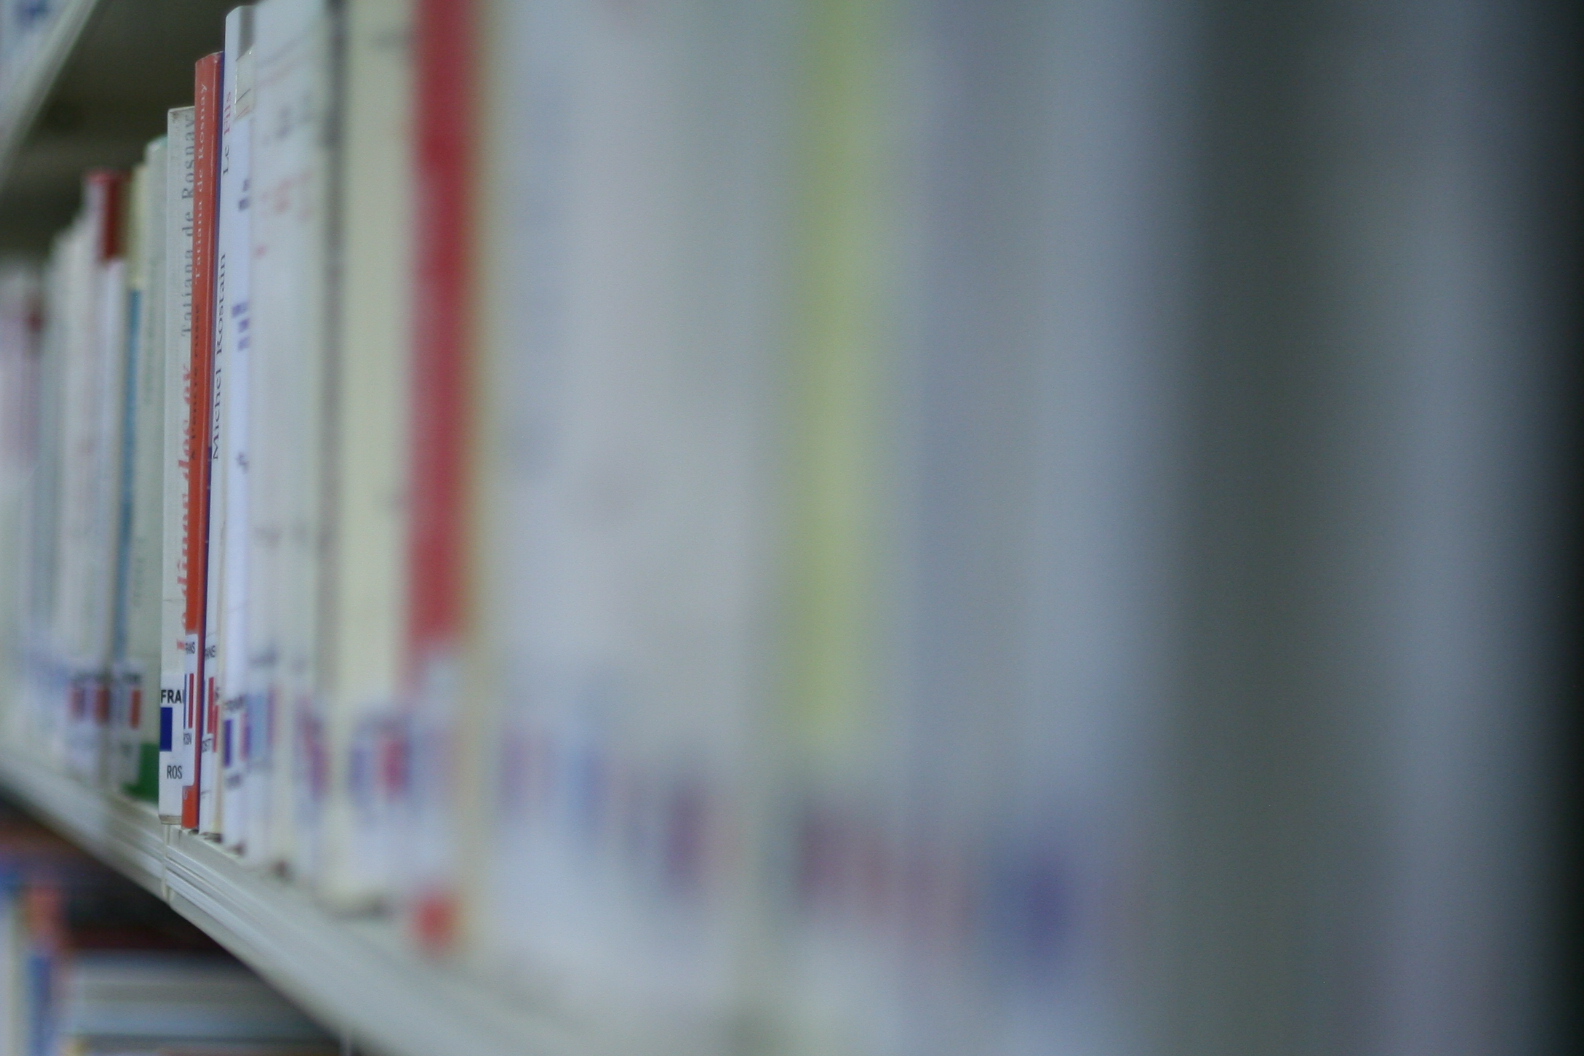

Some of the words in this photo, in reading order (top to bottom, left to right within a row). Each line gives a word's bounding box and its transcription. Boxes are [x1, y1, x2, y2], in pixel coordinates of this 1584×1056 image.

[181, 113, 195, 200] Rosnay
[197, 82, 208, 162] Rosnay
[196, 168, 204, 193] de
[194, 200, 204, 286] Tatiana
[181, 249, 193, 338] Tatiana
[216, 253, 226, 355] Rostain
[213, 368, 222, 460] Michel
[161, 689, 184, 704] FRA
[167, 765, 183, 779] ROS
